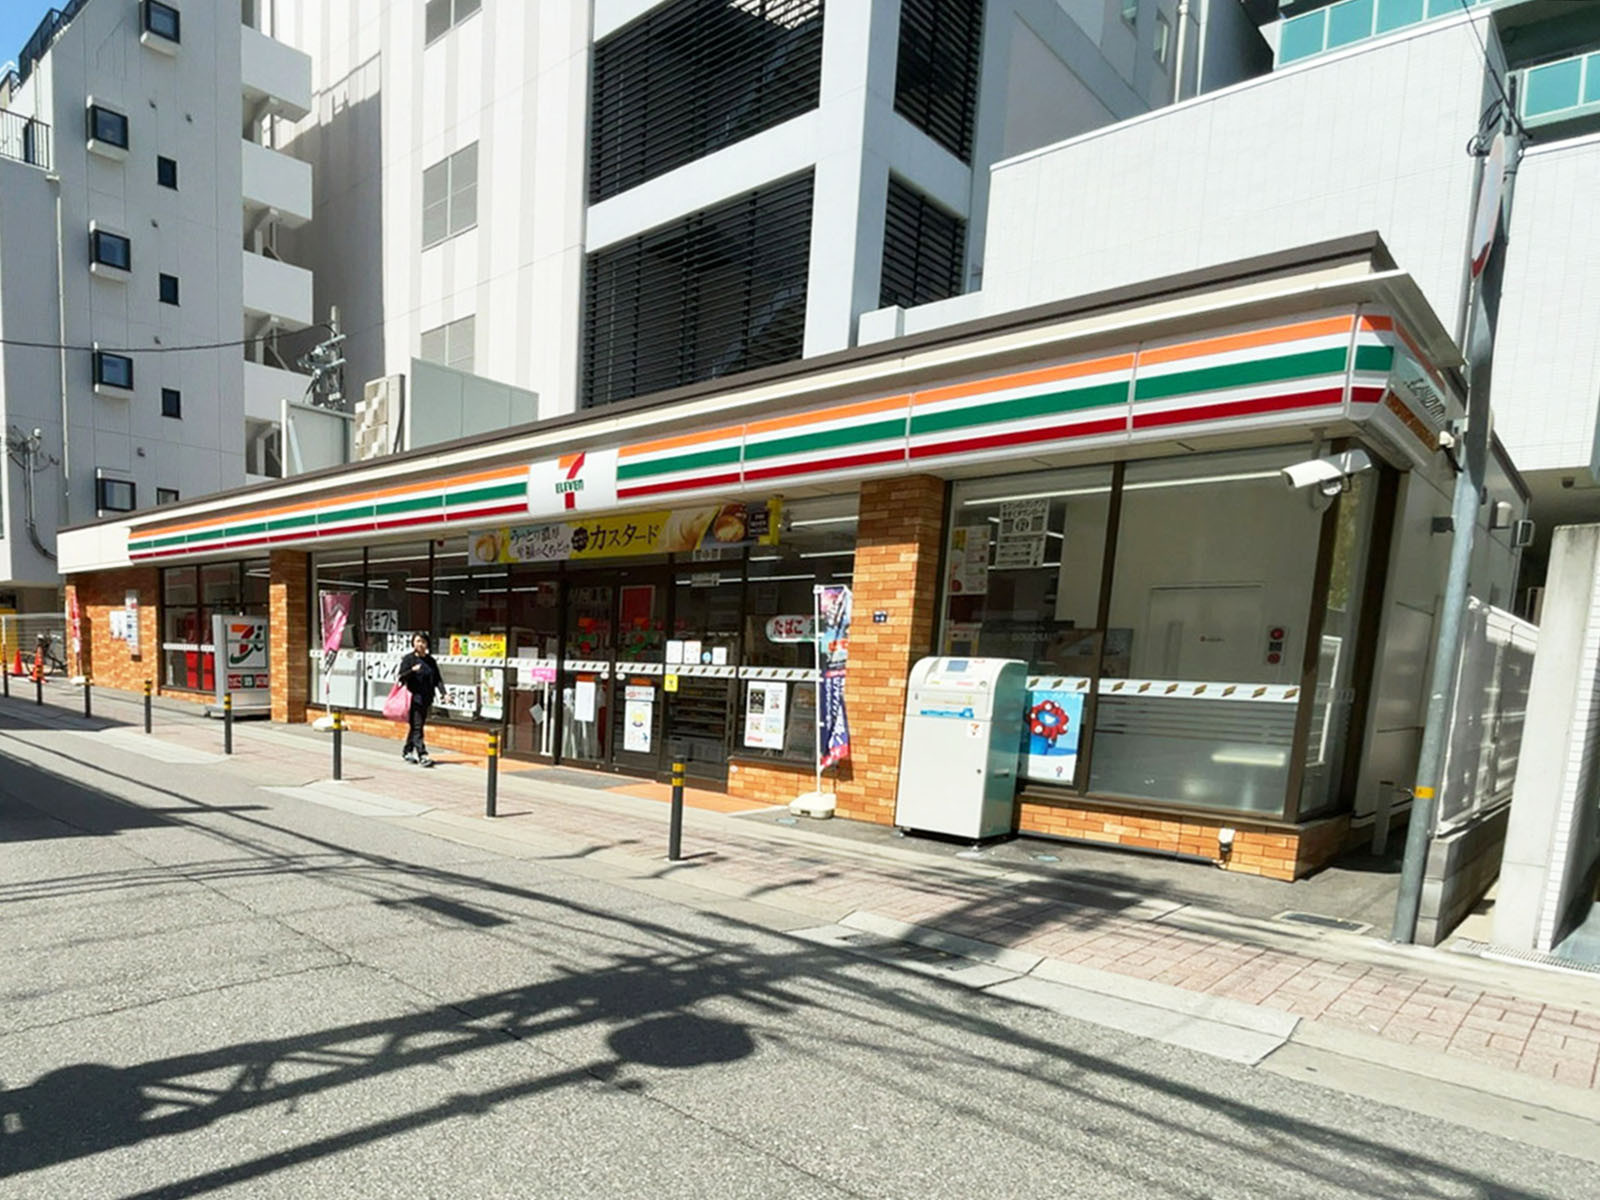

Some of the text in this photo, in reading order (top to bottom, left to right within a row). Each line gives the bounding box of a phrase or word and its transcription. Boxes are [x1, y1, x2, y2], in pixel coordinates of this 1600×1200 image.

[590, 523, 659, 551] カスタード
[773, 618, 803, 636] たばこ
